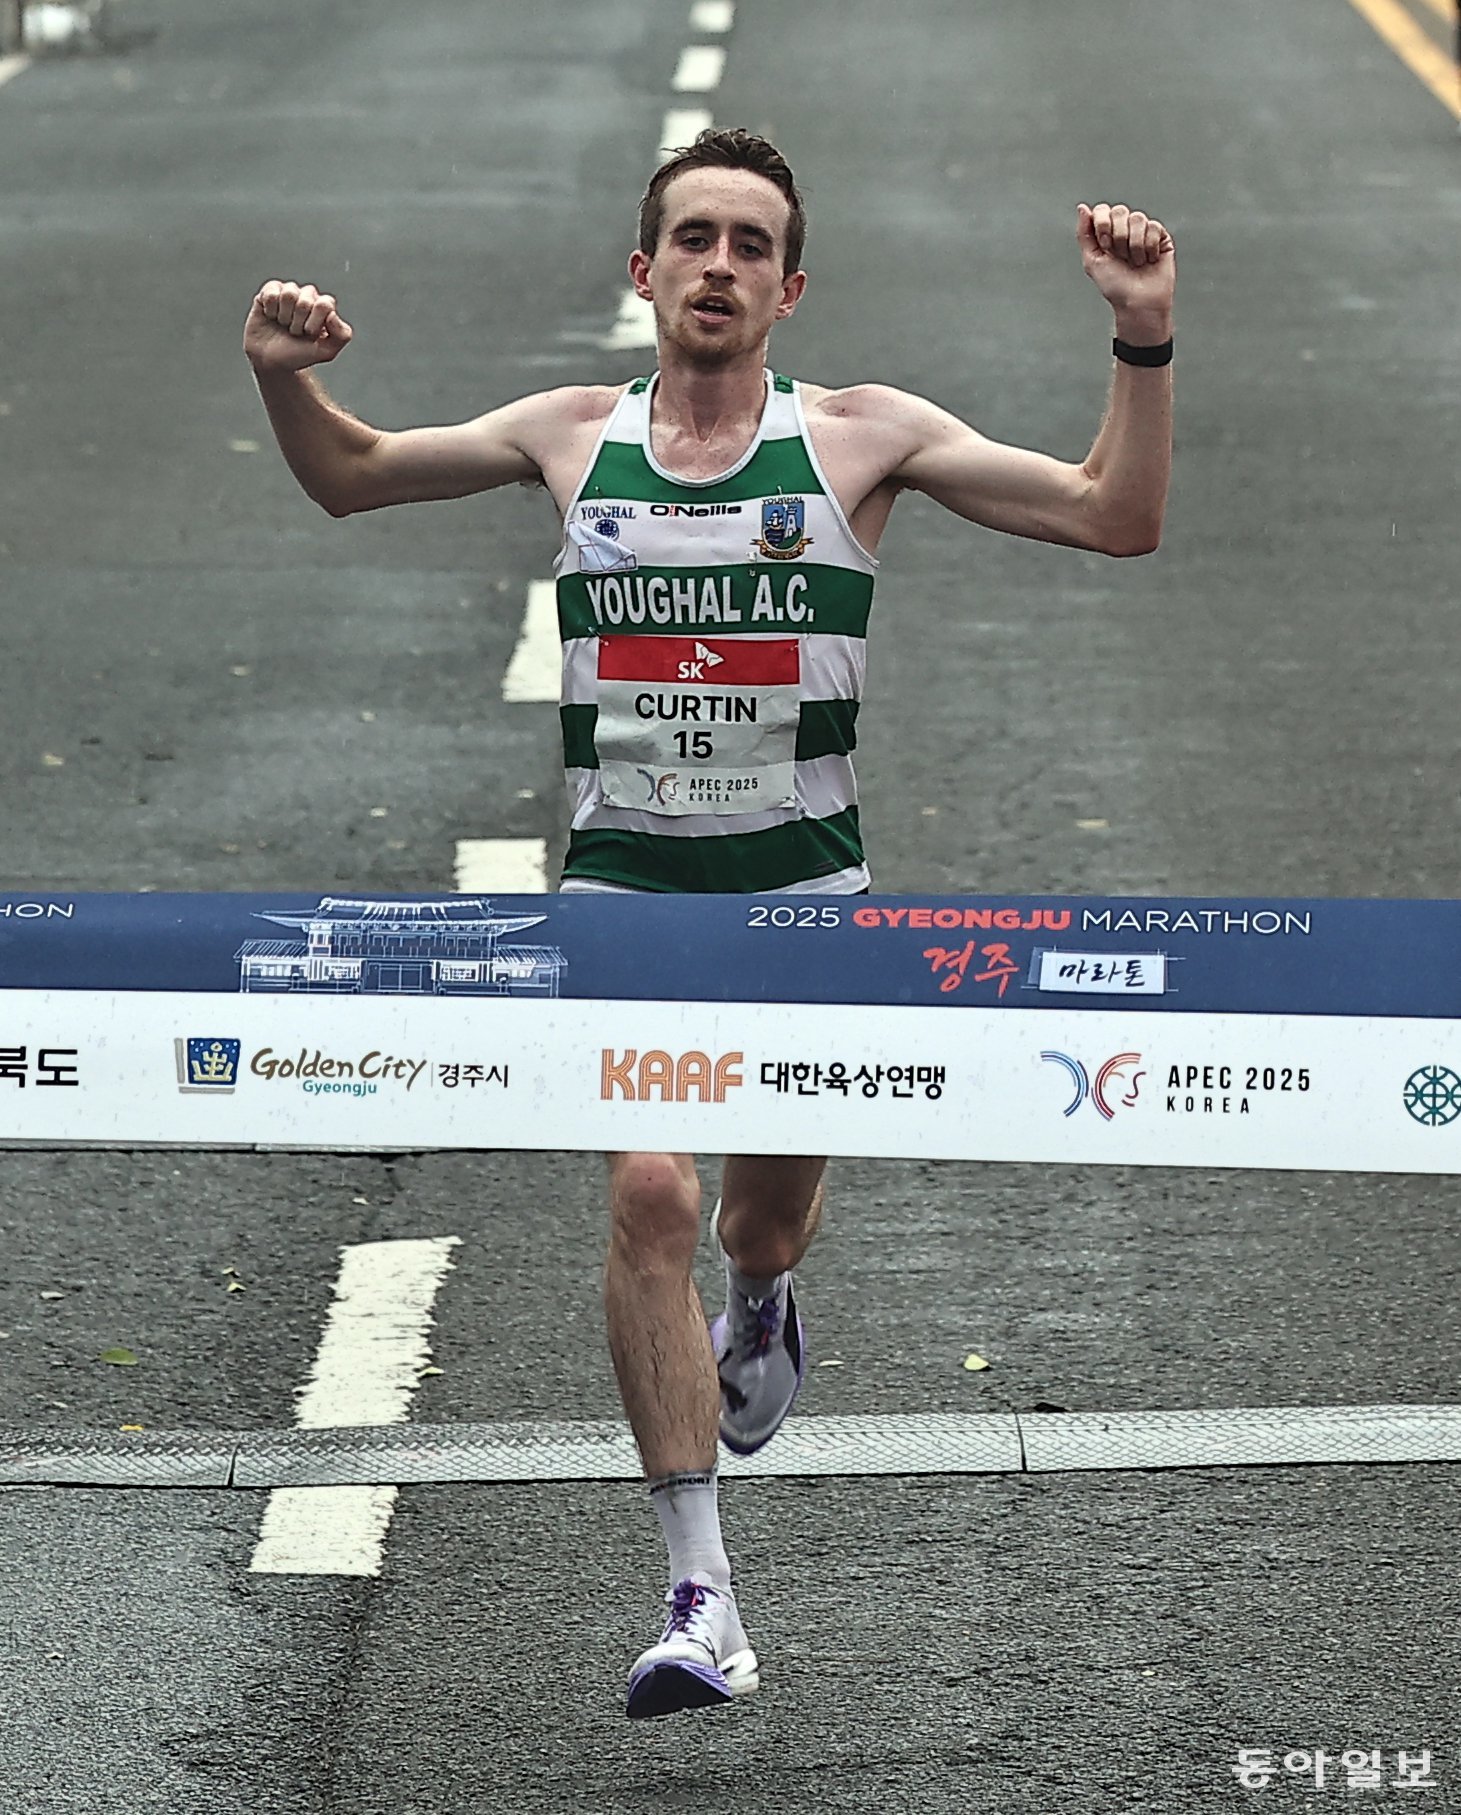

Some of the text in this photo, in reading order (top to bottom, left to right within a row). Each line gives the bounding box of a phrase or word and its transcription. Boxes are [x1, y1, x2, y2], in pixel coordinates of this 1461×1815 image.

[581, 505, 637, 521] YOUGHAL
[586, 574, 814, 625] YOUGHAL A.C.
[677, 661, 704, 680] SK
[635, 693, 757, 722] CURTIN
[673, 731, 713, 759] 15
[689, 793, 730, 802] KOREA
[690, 777, 758, 791] APEC 2025
[747, 906, 1311, 934] 2025 GYEONGJU MARATHON
[923, 940, 1146, 998] 경주 마라톤
[0, 1046, 79, 1088] 북도
[250, 1047, 427, 1092] Golden City
[438, 1062, 510, 1089] 경주시
[600, 1048, 744, 1103] KAAF
[760, 1061, 946, 1100] 대한육상연맹
[1167, 1065, 1311, 1092] APEC 2025
[302, 1079, 378, 1097] Gyeongju
[1166, 1096, 1250, 1114] KOREA
